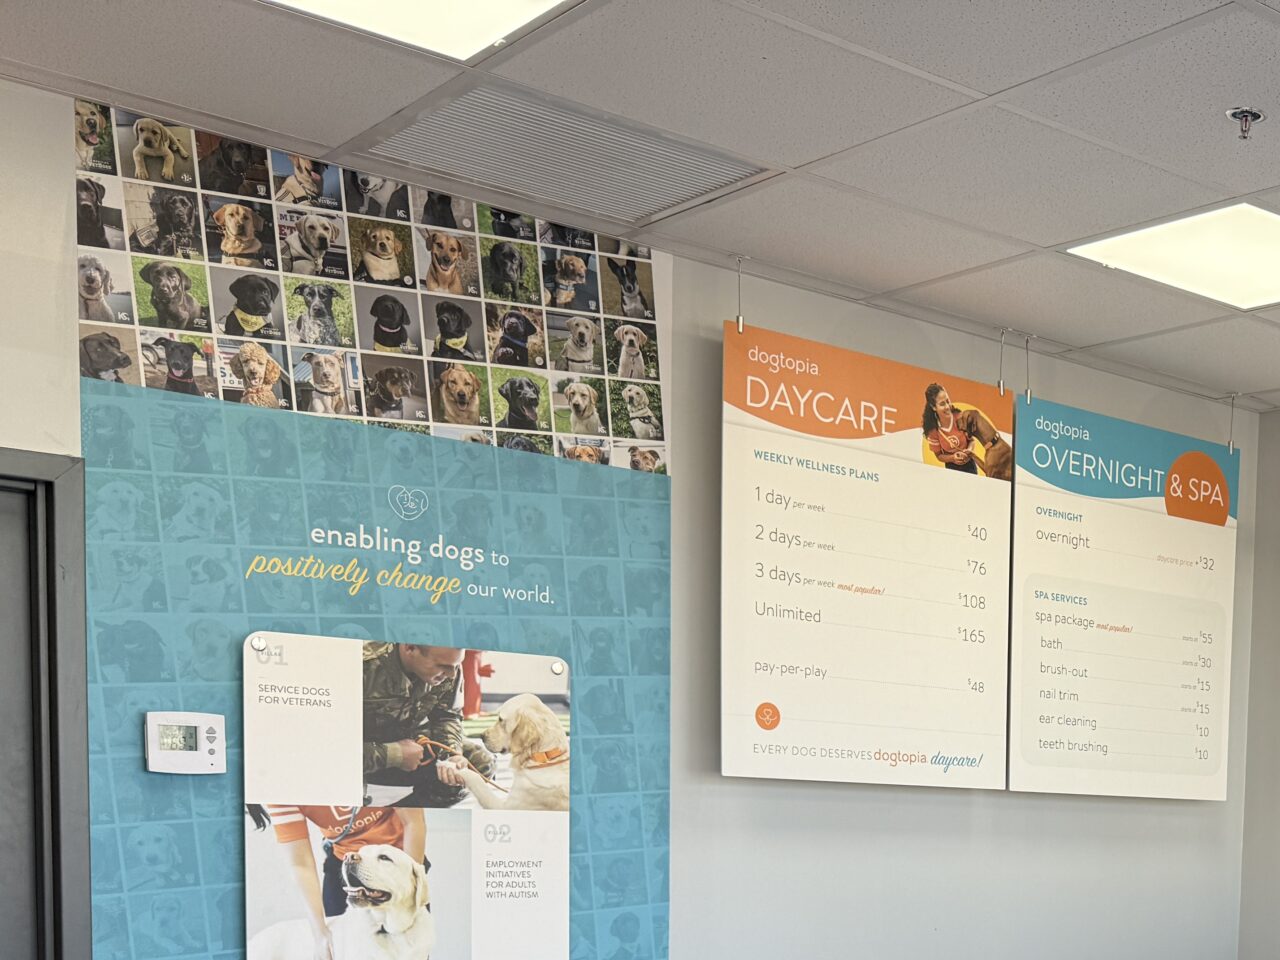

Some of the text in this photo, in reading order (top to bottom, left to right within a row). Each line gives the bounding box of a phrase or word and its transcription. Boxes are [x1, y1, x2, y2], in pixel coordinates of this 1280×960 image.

[748, 345, 820, 375] dogtopia
[746, 375, 898, 436] DAYCARE
[1035, 416, 1090, 441] dogtopia
[754, 449, 880, 483] WEEKLY WELLNESS PLANS
[1032, 443, 1224, 507] OVERNIGHT & SPA
[754, 486, 988, 541] 1 day per week $40
[1036, 506, 1083, 523] OVERNIGHT
[310, 524, 510, 571] enabling dogs to
[1036, 529, 1091, 550] overnight
[755, 525, 987, 576] 2 days per week $76
[245, 554, 555, 605] positively change our world.
[755, 562, 765, 578] 3
[769, 566, 802, 585] days
[803, 577, 816, 587] per
[817, 578, 836, 589] week
[958, 592, 986, 610] $108
[1034, 590, 1088, 606] SPA SERVICES
[755, 601, 822, 624] Unlimited
[1035, 611, 1052, 625] spa
[1055, 613, 1095, 630] package
[957, 626, 986, 644] $165
[1040, 636, 1063, 650] bath
[754, 660, 828, 680] pay-per-play
[1040, 662, 1088, 679] brush-out
[258, 683, 331, 697] SERVICE DOGS
[967, 678, 985, 693] $48
[258, 695, 332, 708] FOR VETERANS
[1039, 688, 1056, 700] nail
[1059, 689, 1079, 702] trim
[1039, 713, 1055, 724] ear
[1057, 715, 1097, 731] cleaning
[1039, 738, 1065, 750] teeth
[1067, 740, 1108, 755] brushing
[753, 743, 984, 773] EVERY DOG DESERVES dogtopia daycare!
[484, 823, 512, 843] 02
[485, 860, 543, 868] EMPLOYMENT
[485, 870, 532, 878] INITIATIVES
[485, 880, 537, 889] FOR ADULTS
[485, 891, 539, 899] WITH AUTISM
